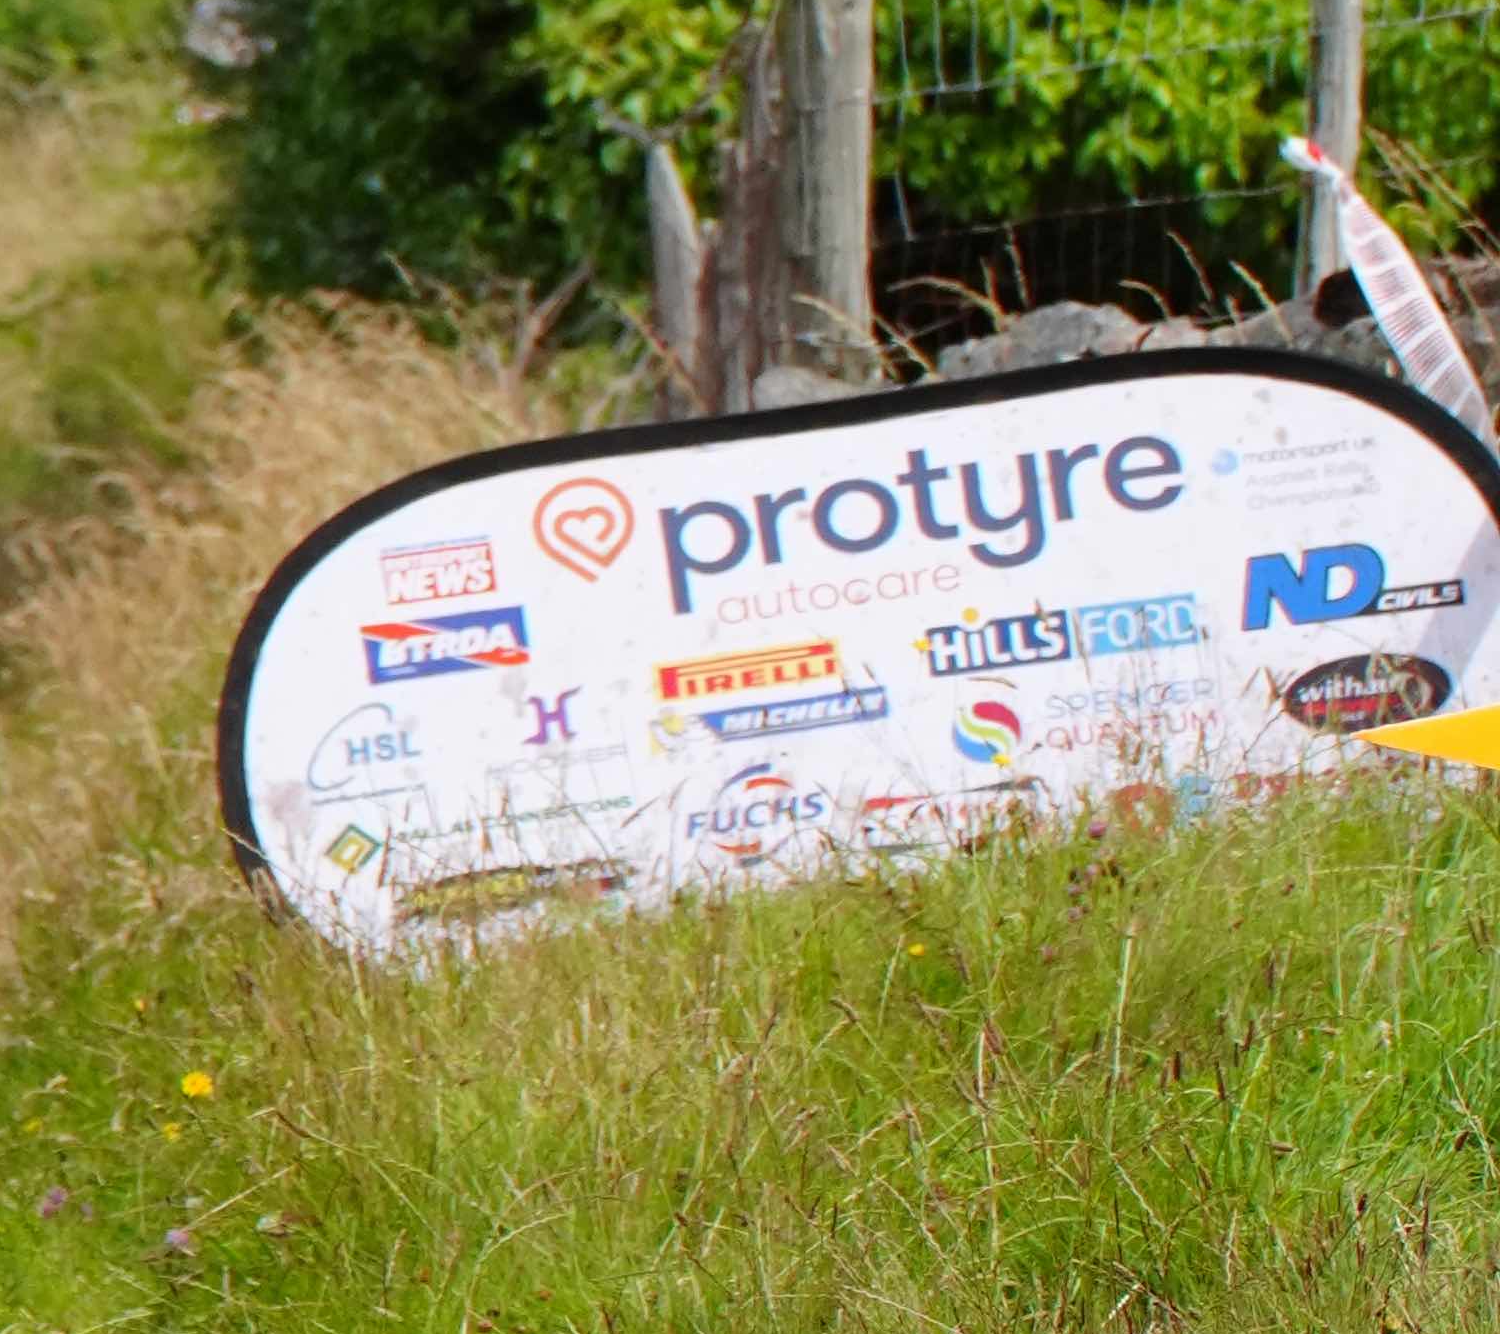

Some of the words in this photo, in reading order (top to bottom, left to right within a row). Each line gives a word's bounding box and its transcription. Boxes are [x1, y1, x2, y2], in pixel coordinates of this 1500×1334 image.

[658, 434, 1184, 615] protyre
[388, 558, 493, 604] NEWS
[717, 561, 962, 624] autocare
[1242, 543, 1385, 631] ND
[1079, 600, 1196, 654] FORD
[658, 642, 837, 699] PIRELLI
[344, 731, 422, 766] HSL
[686, 791, 825, 839] FUCHS
